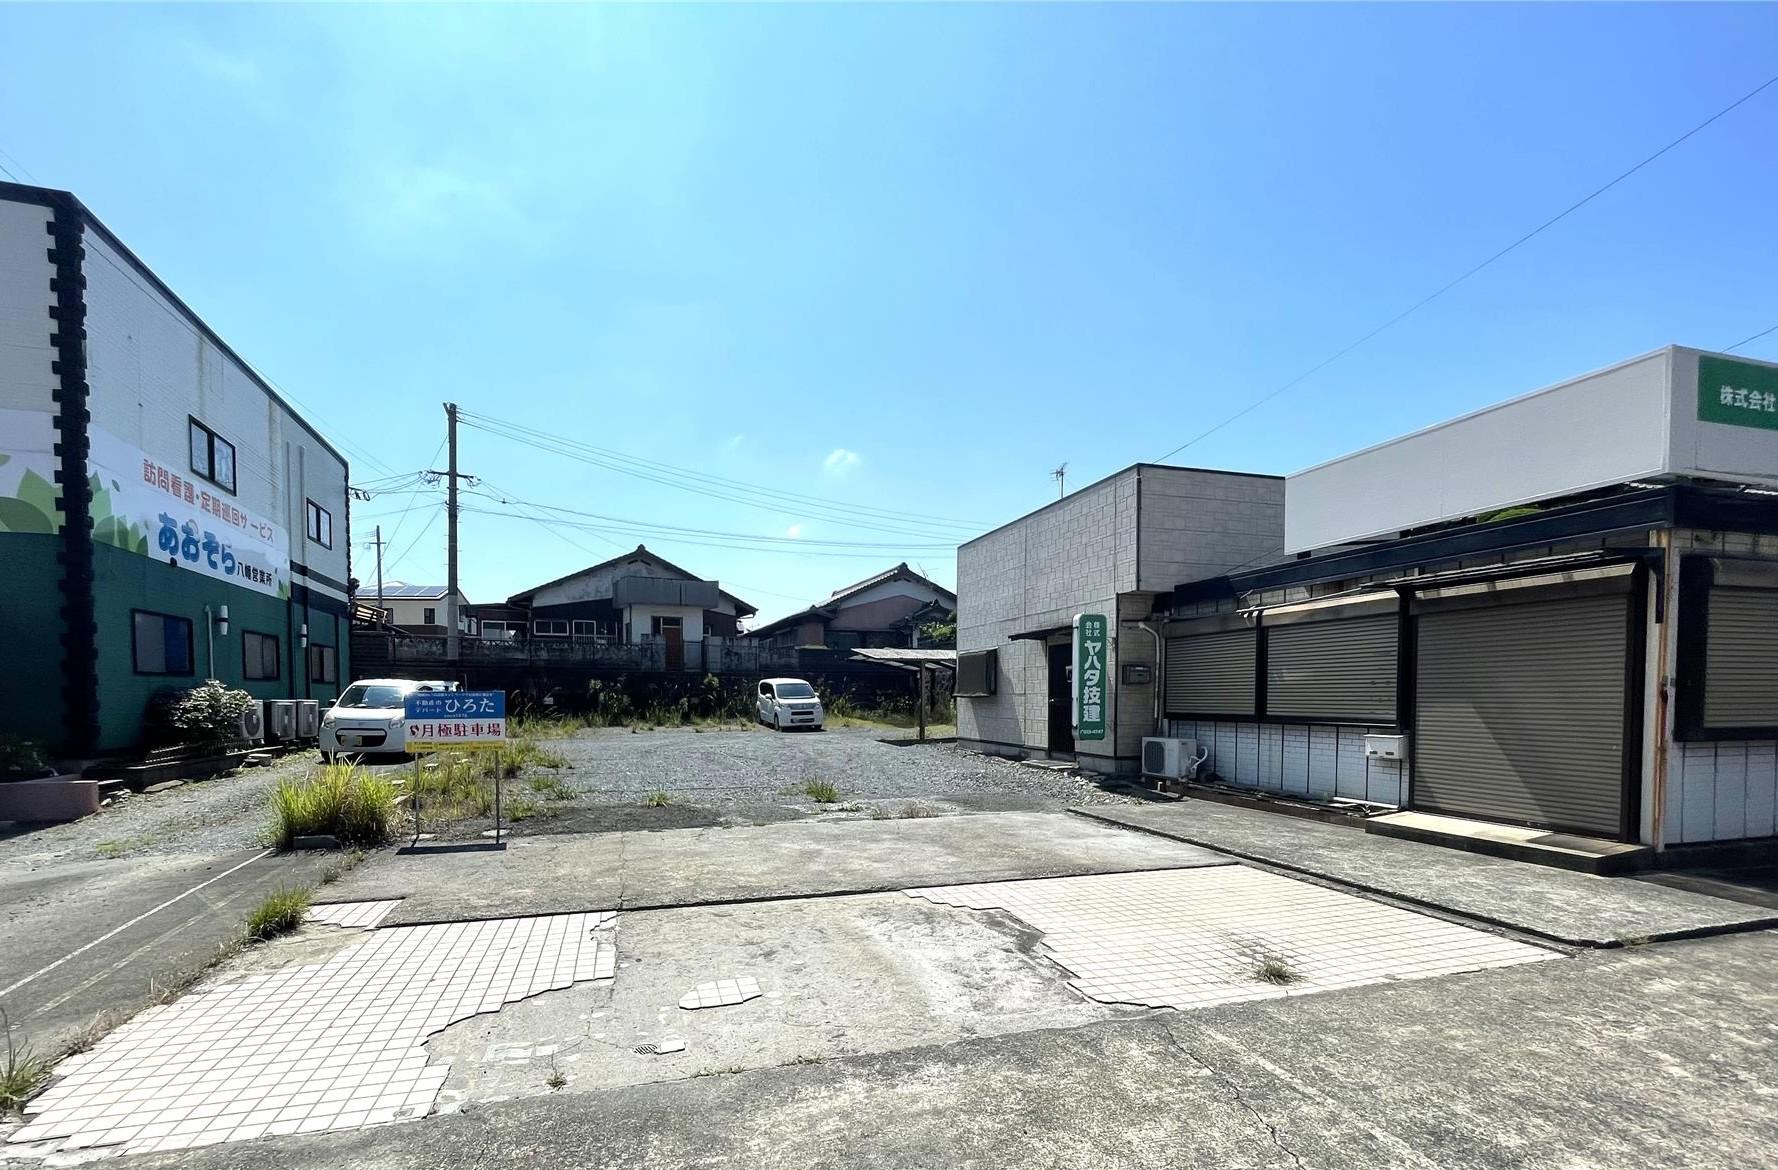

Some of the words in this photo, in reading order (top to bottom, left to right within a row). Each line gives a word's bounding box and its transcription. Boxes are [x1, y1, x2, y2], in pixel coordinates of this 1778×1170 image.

[1720, 385, 1776, 412] 株式会社
[158, 511, 236, 575] あおそら
[236, 561, 273, 587] 八幡営業所
[1083, 639, 1102, 722] ヤハタ技建
[444, 698, 495, 713] ひろた
[422, 722, 501, 737] 月極駐車場
